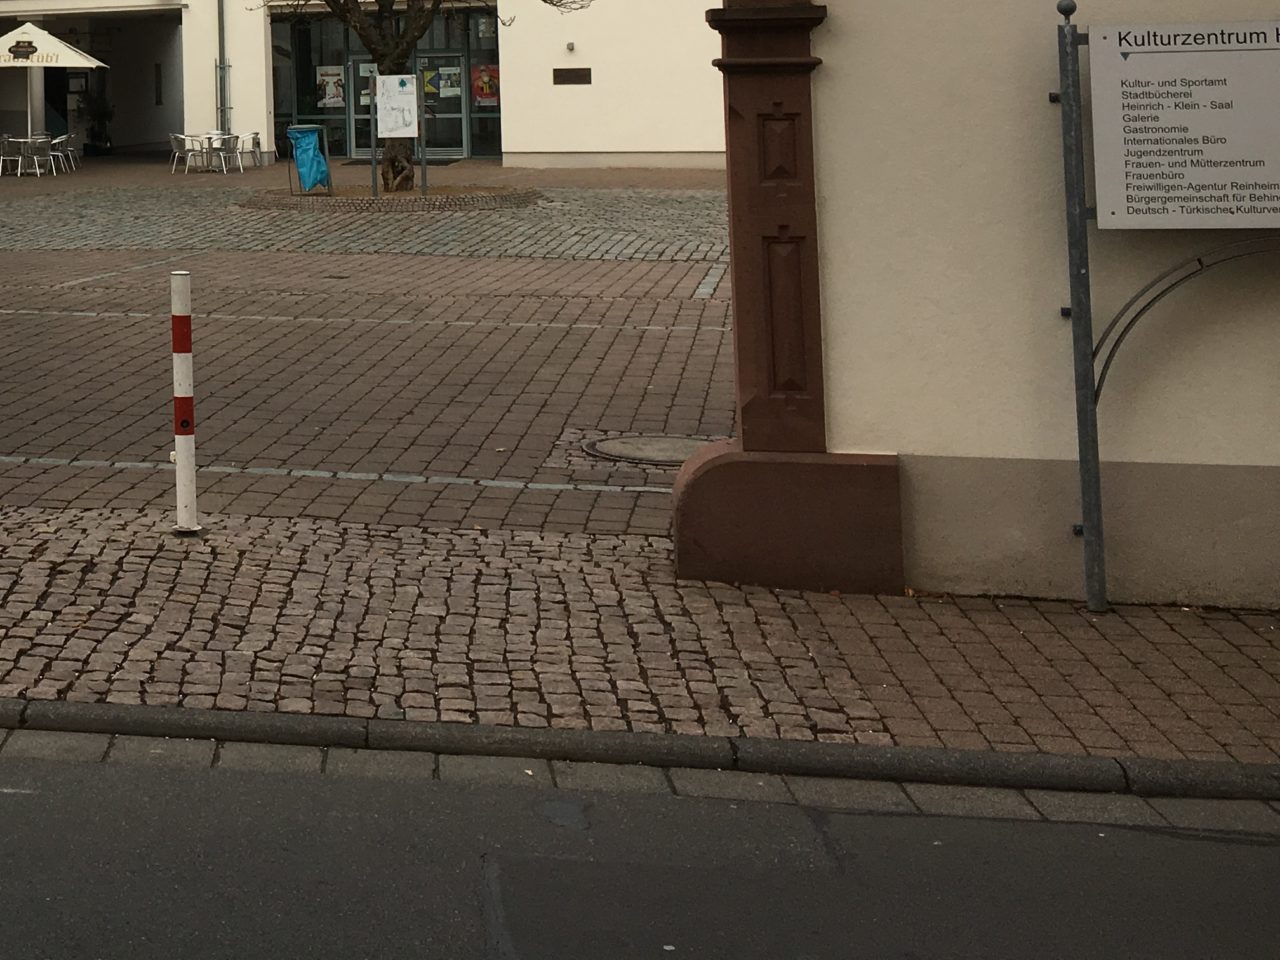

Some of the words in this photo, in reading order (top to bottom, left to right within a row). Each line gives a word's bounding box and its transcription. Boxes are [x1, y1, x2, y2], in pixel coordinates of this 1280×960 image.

[1118, 29, 1267, 48] Kulturzentrum
[1121, 79, 1155, 88] Kultur-
[1157, 79, 1177, 88] und
[1180, 77, 1227, 89] Sportamt
[1121, 90, 1192, 100] Stadtbücherei
[1122, 101, 1164, 111] Heinrich
[1174, 101, 1200, 110] Klein
[1210, 100, 1233, 110] Saal
[1122, 113, 1160, 123] Galerie
[1123, 124, 1189, 134] Gastronomie
[1123, 136, 1199, 146] Internationales
[1202, 135, 1227, 145] Büro
[1124, 147, 1204, 159] Jugendzentrum
[1125, 159, 1165, 168] Frauen-
[1167, 159, 1187, 168] und
[1190, 158, 1265, 168] Mütterzentrum
[1125, 170, 1185, 180] Frauenbüro
[1126, 182, 1227, 193] Freiwilligen-Agentur
[1231, 181, 1280, 191] Reinheim
[1126, 193, 1230, 206] Bürgergemeinschaft
[1232, 193, 1246, 203] für
[1127, 205, 1169, 215] Deutsch
